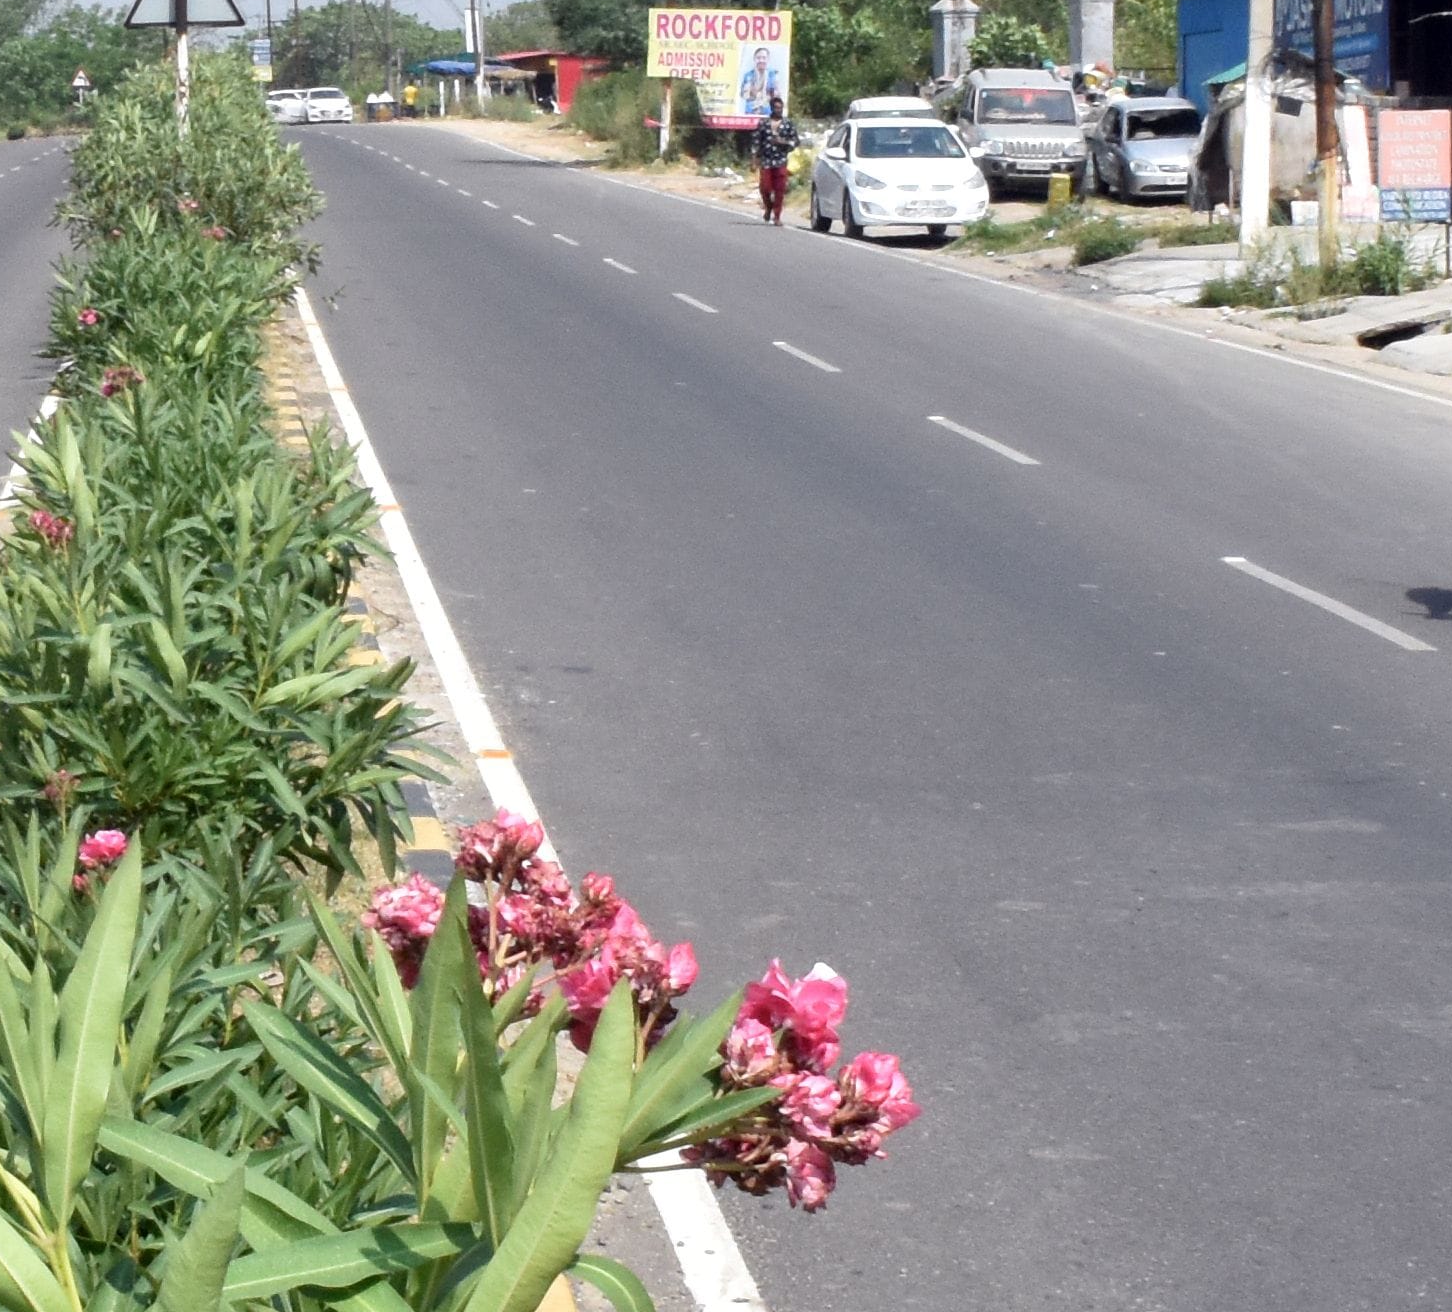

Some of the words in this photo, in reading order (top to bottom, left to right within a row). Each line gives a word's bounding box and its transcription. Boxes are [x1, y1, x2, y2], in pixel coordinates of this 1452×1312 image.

[656, 13, 782, 42] ROCKFORD
[658, 51, 725, 68] ADMISSION
[669, 67, 712, 81] OPEN
